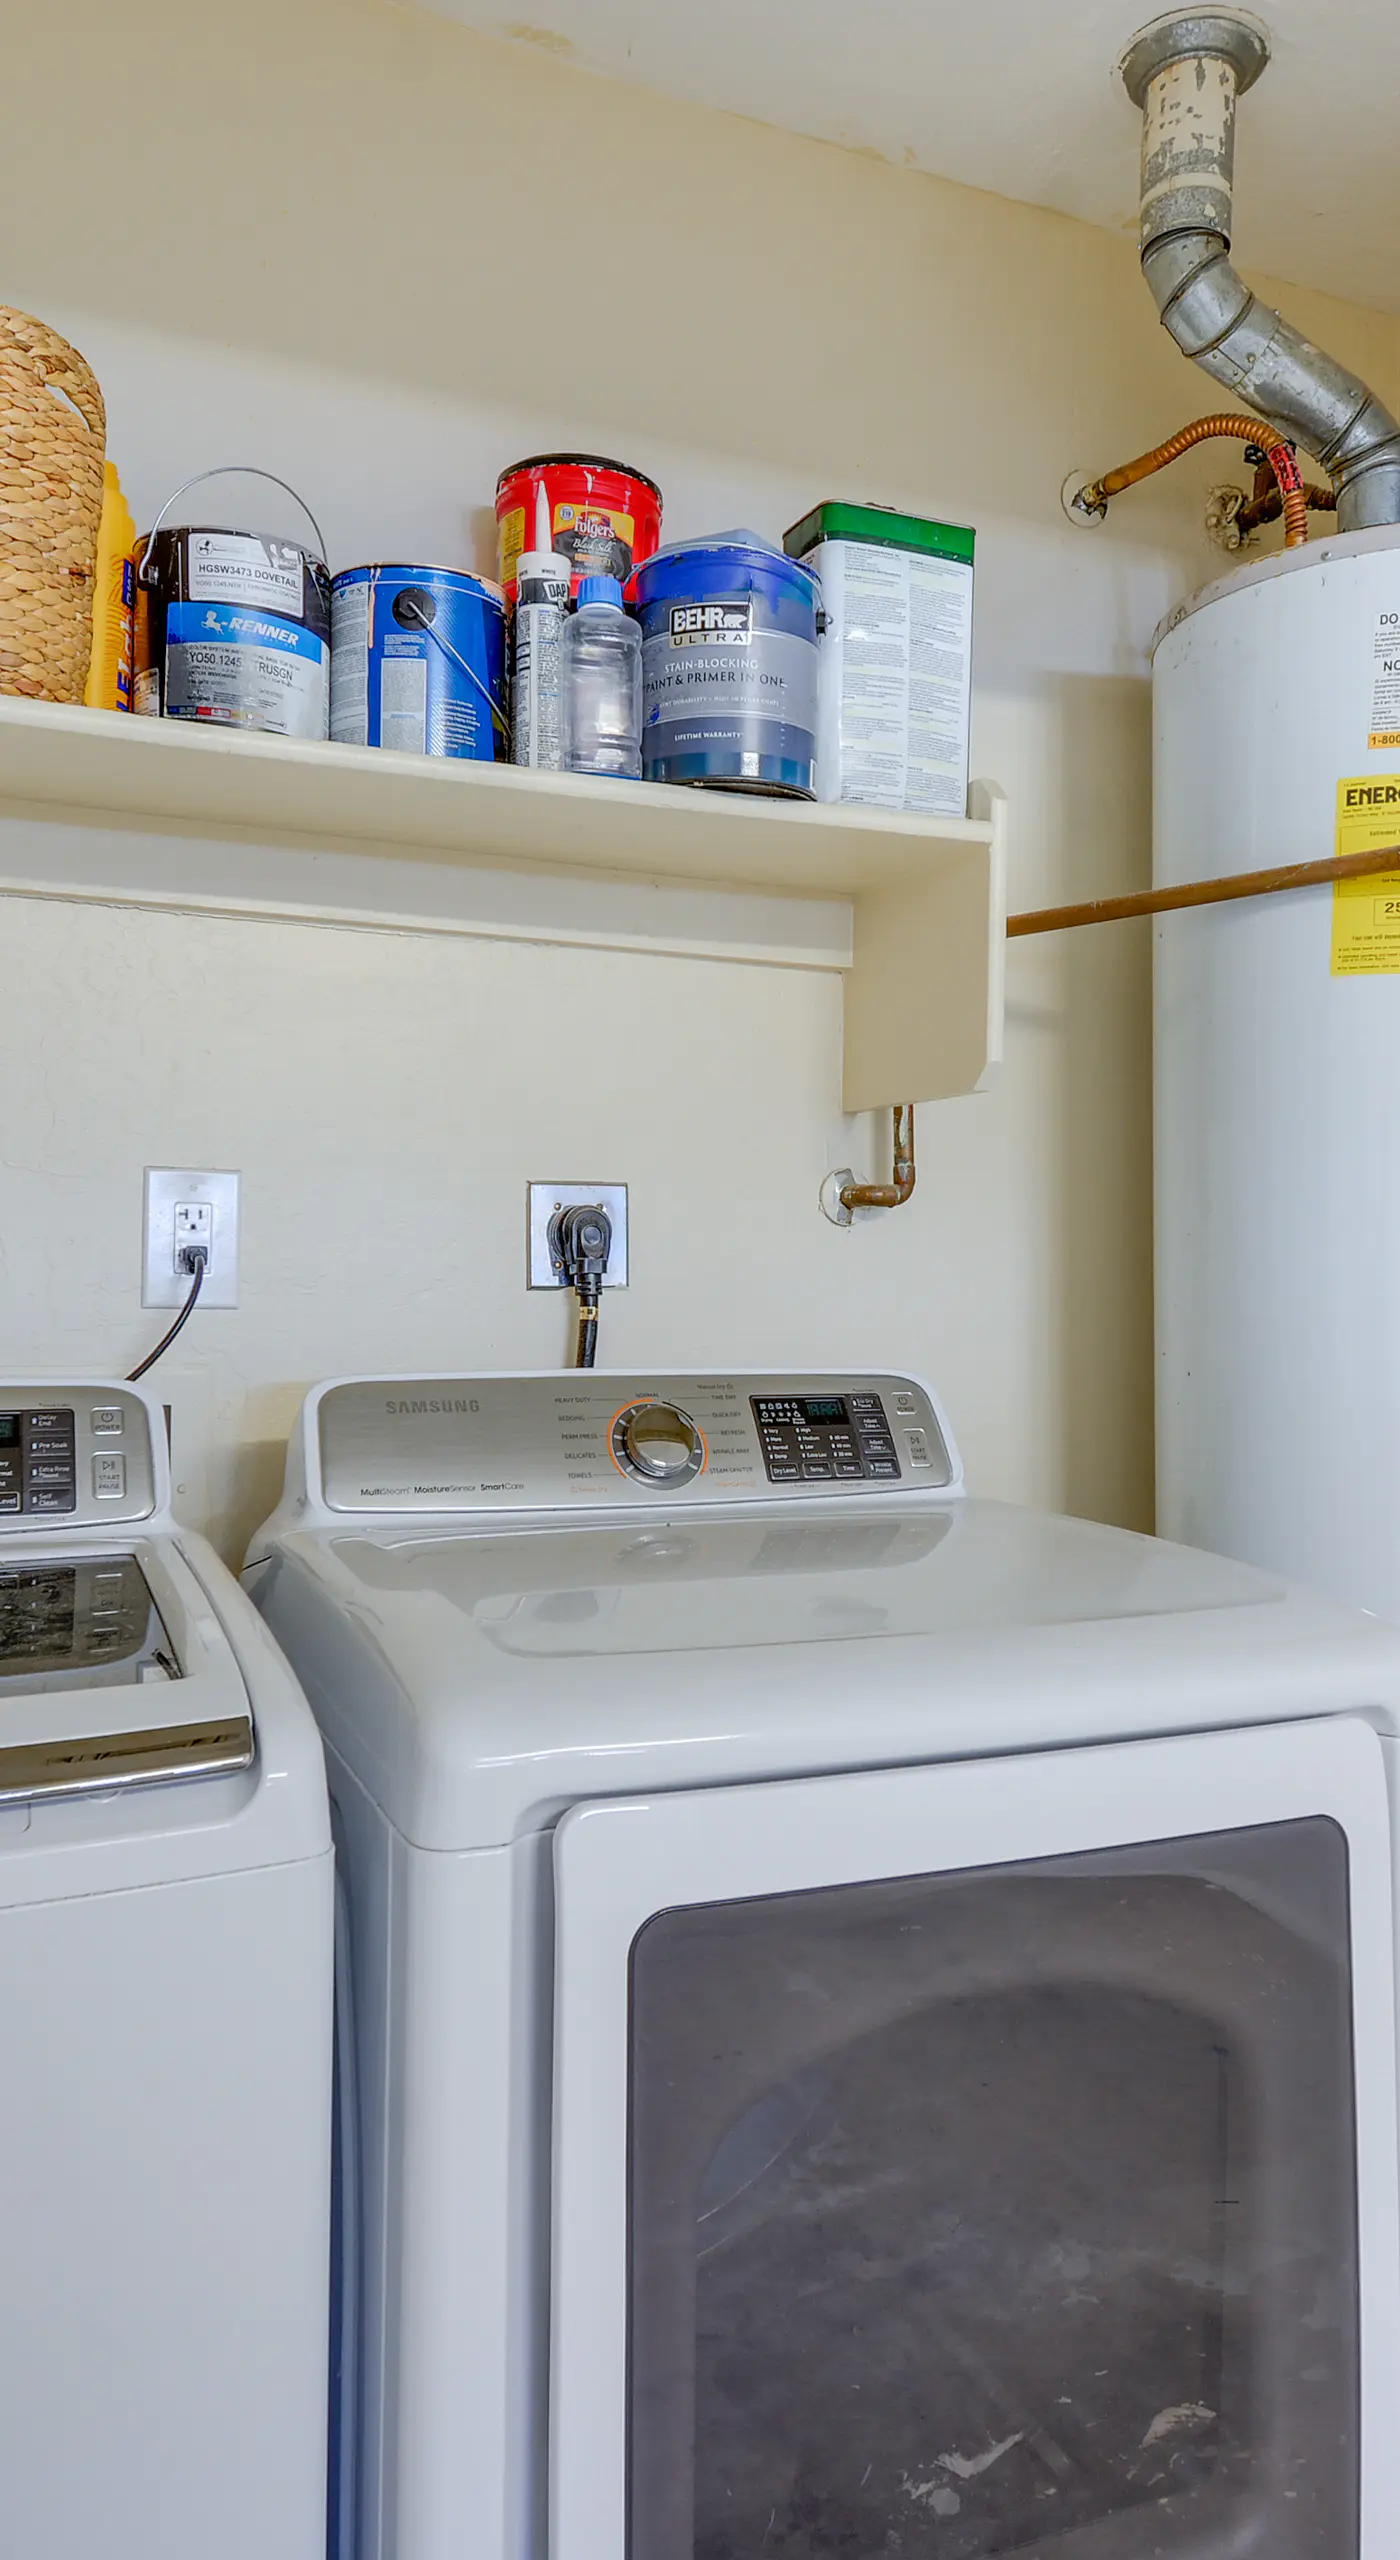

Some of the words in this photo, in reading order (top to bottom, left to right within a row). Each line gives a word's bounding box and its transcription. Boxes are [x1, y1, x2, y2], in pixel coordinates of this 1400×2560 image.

[574, 516, 615, 538] Folgers
[198, 564, 252, 577] HGSW3473
[254, 569, 299, 589] DOVETAIL
[549, 583, 567, 598] DAP
[673, 606, 725, 632] BEHR
[1379, 613, 1399, 625] DO
[228, 616, 300, 646] RENNER
[673, 633, 744, 646] ULTRA
[664, 658, 759, 674] STAIN-BLOCKING
[675, 676, 684, 686] &
[686, 672, 736, 683] PRIMER
[740, 672, 756, 682] IN
[759, 673, 786, 689] ONE
[674, 732, 702, 742] LIFETIME
[703, 732, 742, 740] WARRANTY
[1346, 785, 1400, 807] ENER
[385, 1399, 480, 1415] SAMSUNG
[564, 1452, 597, 1460] DELICATES
[413, 1484, 476, 1494] MoistureSensor
[480, 1482, 525, 1491] SmartCare
